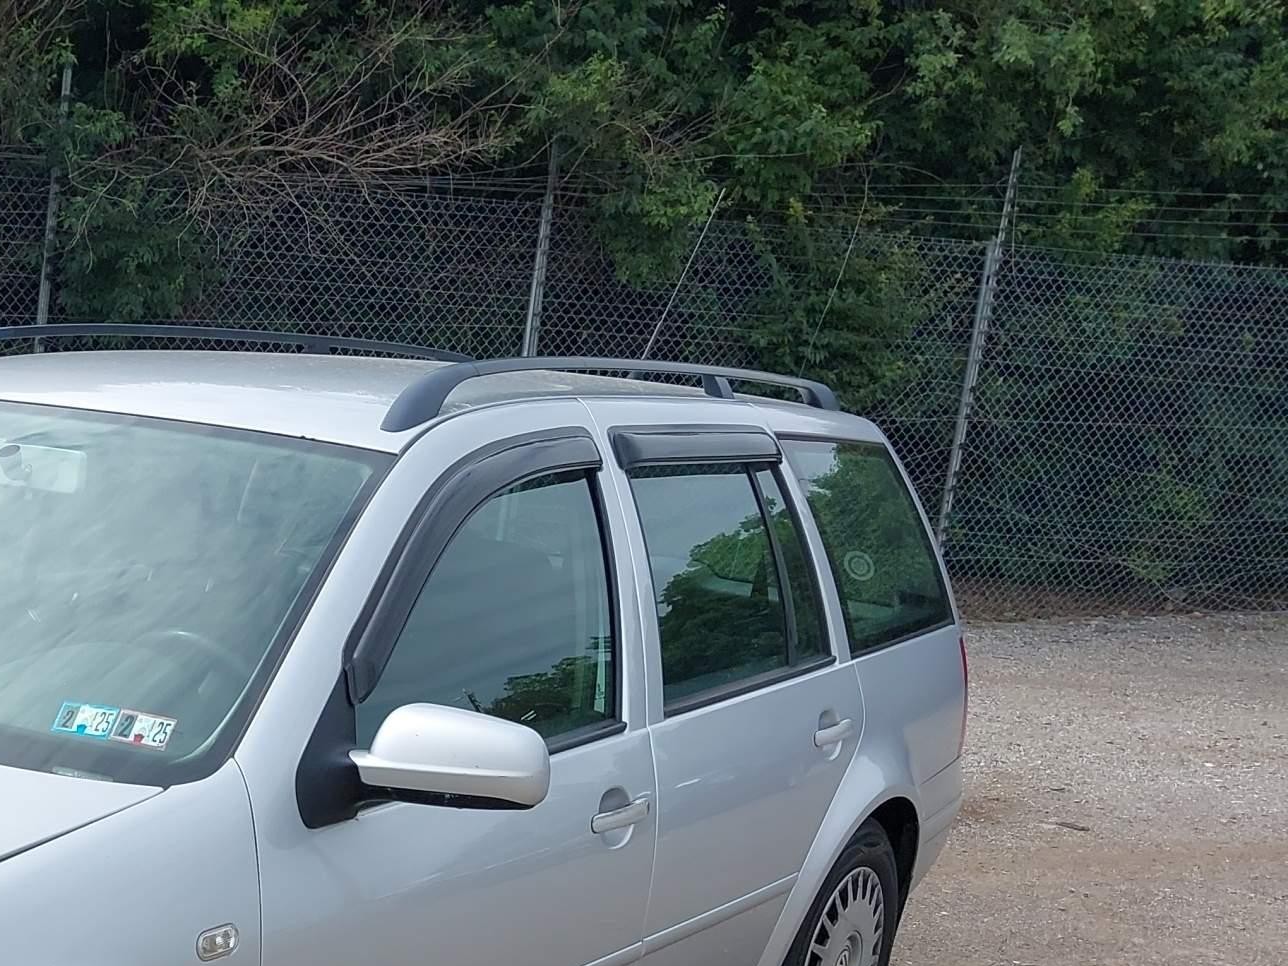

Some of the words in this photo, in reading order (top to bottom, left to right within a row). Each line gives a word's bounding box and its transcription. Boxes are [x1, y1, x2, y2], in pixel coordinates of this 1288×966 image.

[62, 710, 74, 728] 2
[95, 711, 114, 733] 25
[119, 714, 134, 738] 2
[152, 721, 172, 744] 25
